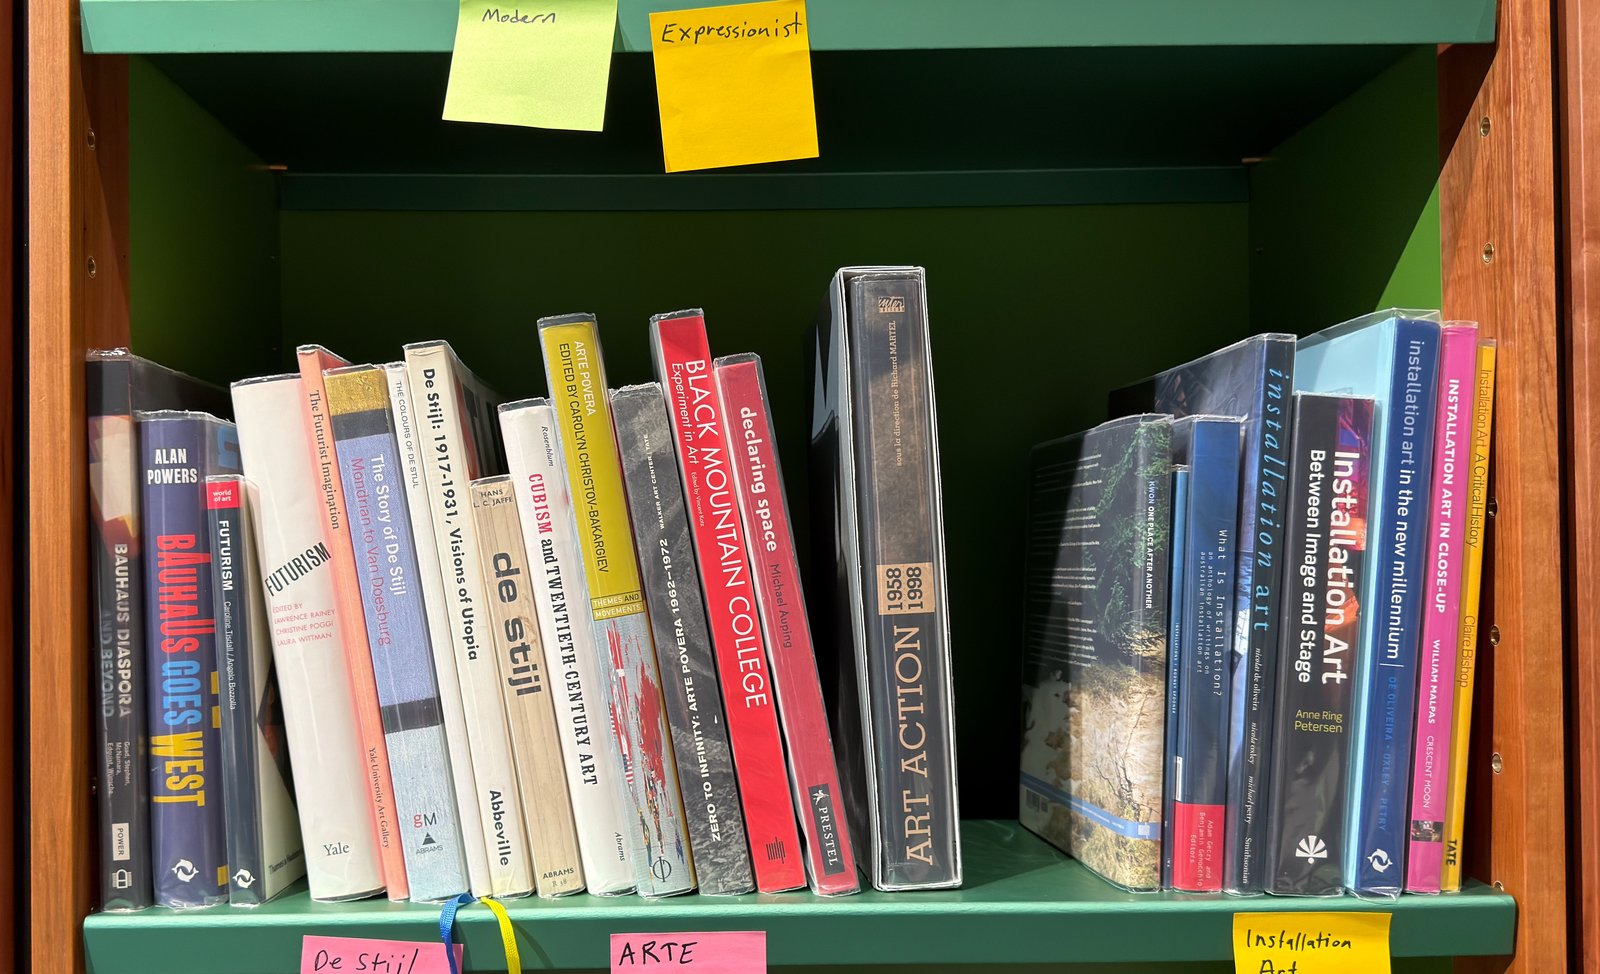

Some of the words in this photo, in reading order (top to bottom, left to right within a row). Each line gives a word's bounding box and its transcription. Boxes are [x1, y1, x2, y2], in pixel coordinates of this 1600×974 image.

[482, 8, 556, 24] Modern
[661, 12, 803, 44] Expressionist
[574, 341, 589, 368] ARTE
[888, 319, 897, 355] MARTEL
[423, 368, 436, 389] De
[559, 343, 575, 383] EDITED
[891, 356, 899, 388] Richard
[309, 389, 321, 409] The
[395, 381, 404, 397] THE
[567, 384, 578, 400] BY
[580, 370, 597, 417] POVERA
[671, 363, 693, 429] Experiment
[685, 359, 718, 439] BLACK
[1403, 340, 1425, 436] installation
[1476, 369, 1492, 429] Installation
[398, 398, 411, 439] COLOURS
[426, 393, 444, 430] Stijl:
[569, 400, 588, 451] CAROLYN
[893, 400, 901, 437] direction
[312, 409, 329, 460] Futurist
[541, 425, 554, 467] Rosenblum
[684, 431, 696, 442] in
[740, 406, 767, 494] declaring
[1443, 379, 1460, 484] INSTALLATION
[1476, 429, 1489, 449] Art
[155, 449, 187, 464] ALAN
[371, 454, 385, 482] The
[648, 455, 657, 484] CENTER
[687, 445, 699, 465] Art
[1258, 367, 1290, 567] installation
[1401, 438, 1416, 465] art
[147, 469, 198, 485] POWERS
[321, 461, 341, 530] Imagination
[351, 457, 372, 526] Mondrian
[434, 434, 459, 525] 1917-1931,
[480, 489, 504, 498] HANS
[652, 486, 660, 499] ART
[1306, 449, 1326, 528] Between
[1399, 469, 1416, 485] in
[1472, 463, 1486, 507] Critical
[376, 482, 391, 524] Story
[528, 473, 553, 534] CUBISM
[578, 451, 609, 573] CHRISTOV-BAKARGIEV
[656, 501, 665, 530] WALKER
[701, 447, 746, 588] MOUNTAIN
[1397, 489, 1413, 518] the
[1441, 489, 1452, 518] ART
[383, 526, 394, 543] of
[755, 498, 777, 552] space
[1217, 529, 1228, 560] What
[1325, 451, 1360, 626] Installation
[1393, 520, 1408, 557] new
[1439, 522, 1450, 538] IN
[1466, 507, 1484, 548] History
[219, 520, 233, 591] FUTURISM
[264, 541, 332, 597] FUTURISM
[366, 546, 380, 573] Van
[385, 543, 399, 563] De
[450, 528, 466, 585] Visions
[541, 539, 559, 565] and
[1299, 533, 1322, 588] Image
[114, 543, 130, 622] BAUHAUS
[156, 534, 217, 654] BAUHAUS
[389, 565, 407, 596] Stijl
[492, 552, 520, 603] de
[659, 538, 680, 613] 1962-1972
[770, 563, 787, 608] Michael
[886, 566, 902, 611] 1958
[906, 566, 924, 610] 1998
[1145, 574, 1153, 609] ANOTHER
[1216, 571, 1227, 585] Is
[1435, 542, 1449, 614] CLOSE-UP
[223, 601, 232, 629] Caroline
[272, 604, 293, 614] EDITED
[371, 576, 392, 647] Doesburg
[458, 588, 473, 603] of
[593, 597, 623, 608] THEMES
[624, 593, 640, 602] AND
[595, 604, 641, 618] MOVEMENTS
[1254, 585, 1270, 632] art
[1301, 592, 1318, 626] and
[1387, 561, 1408, 659] millennium
[274, 613, 309, 624] LAWRENCE
[310, 609, 336, 618] RAINEY
[275, 624, 308, 636] CHRISTINE
[309, 620, 334, 631] POGGI
[462, 607, 480, 661] Utopia
[778, 609, 793, 649] Auping
[1463, 615, 1476, 648] Claire
[277, 637, 297, 647] LAURA
[298, 632, 332, 643] WITTMAN
[504, 617, 542, 696] stijl
[546, 565, 592, 747] TWENTIETH-CENTURY
[674, 618, 691, 673] POVERA
[728, 596, 768, 709] COLLEGE
[1213, 595, 1226, 696] Installation?
[1294, 629, 1316, 683] Stage
[1321, 633, 1350, 685] Art
[117, 628, 133, 717] DIASPORA
[225, 657, 235, 681] Angelo
[1430, 639, 1440, 683] WILLIAM
[1459, 648, 1473, 688] Bishop
[101, 648, 115, 718] BEYOND
[161, 660, 202, 726] GOES
[684, 675, 699, 711] ARTE
[893, 625, 929, 778] ACTION
[1295, 709, 1320, 720] Anne
[1322, 711, 1343, 723] Ring
[1384, 692, 1396, 741] OLIVEIRA
[1427, 685, 1438, 724] MALPAS
[692, 714, 709, 778] INFINITY:
[1294, 721, 1343, 734] Petersen
[151, 730, 205, 807] WEST
[579, 753, 598, 785] ART
[1425, 735, 1434, 779] CRESCENT
[371, 764, 382, 804] University
[380, 820, 390, 849] Gallery
[702, 781, 713, 800] TO
[1423, 780, 1431, 808] MOON
[489, 790, 512, 866] Abbeville
[706, 803, 721, 842] ZERO
[902, 789, 933, 866] ART
[1198, 812, 1206, 845] Benjamin
[1377, 797, 1389, 832] PETRY
[323, 842, 350, 857] Yale
[415, 844, 444, 855] ABRAMS
[614, 831, 625, 861] Abrams
[818, 807, 839, 866] PRESTEL
[1189, 834, 1197, 863] Editors
[1445, 839, 1457, 866] TATE
[543, 867, 575, 879] ABRAMS
[1242, 836, 1253, 884] Smithsonian
[619, 940, 698, 966] ARTE
[1246, 929, 1352, 952] Installation
[315, 949, 342, 971] De
[356, 949, 419, 974] Stijl
